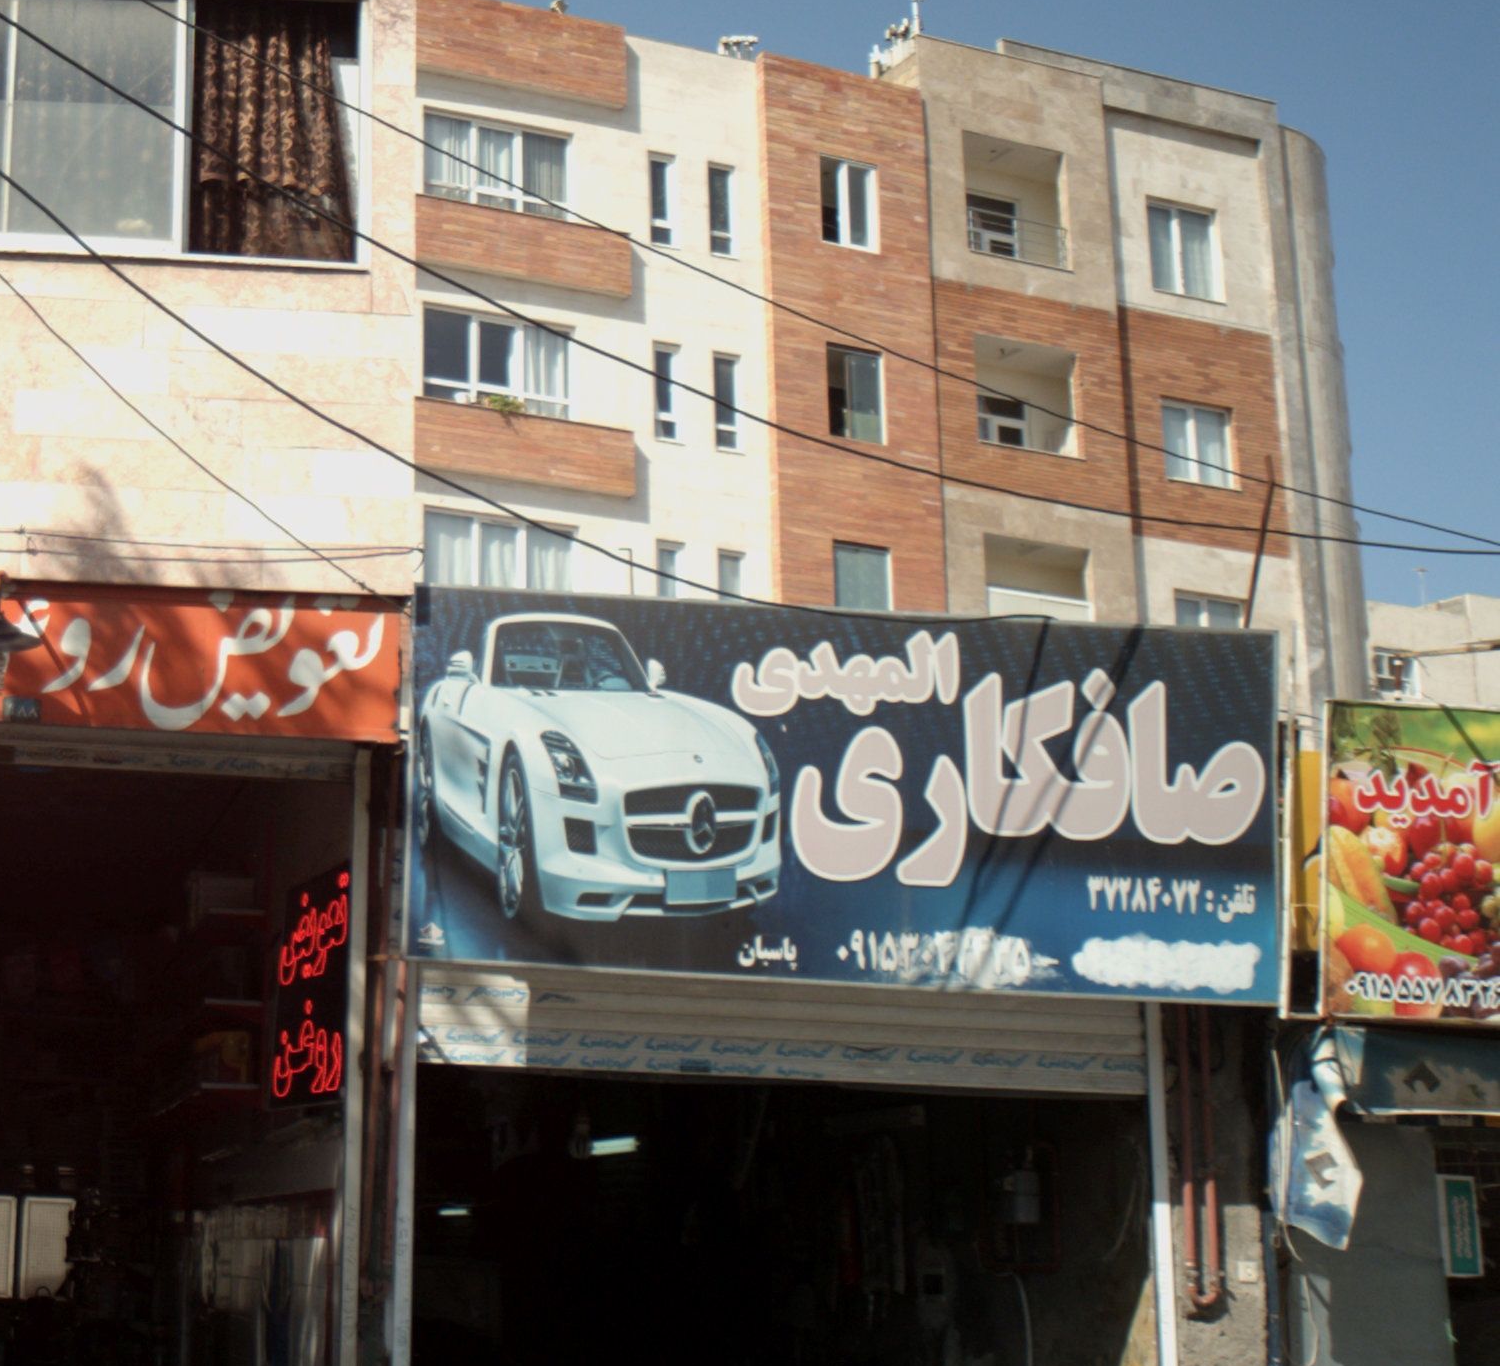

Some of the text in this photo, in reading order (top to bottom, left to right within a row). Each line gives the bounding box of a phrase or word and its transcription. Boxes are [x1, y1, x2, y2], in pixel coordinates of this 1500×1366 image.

[730, 630, 960, 717] المهدی
[790, 667, 1265, 887] صافکاری
[738, 935, 798, 970] پاسبان
[271, 997, 344, 1098] روغن
